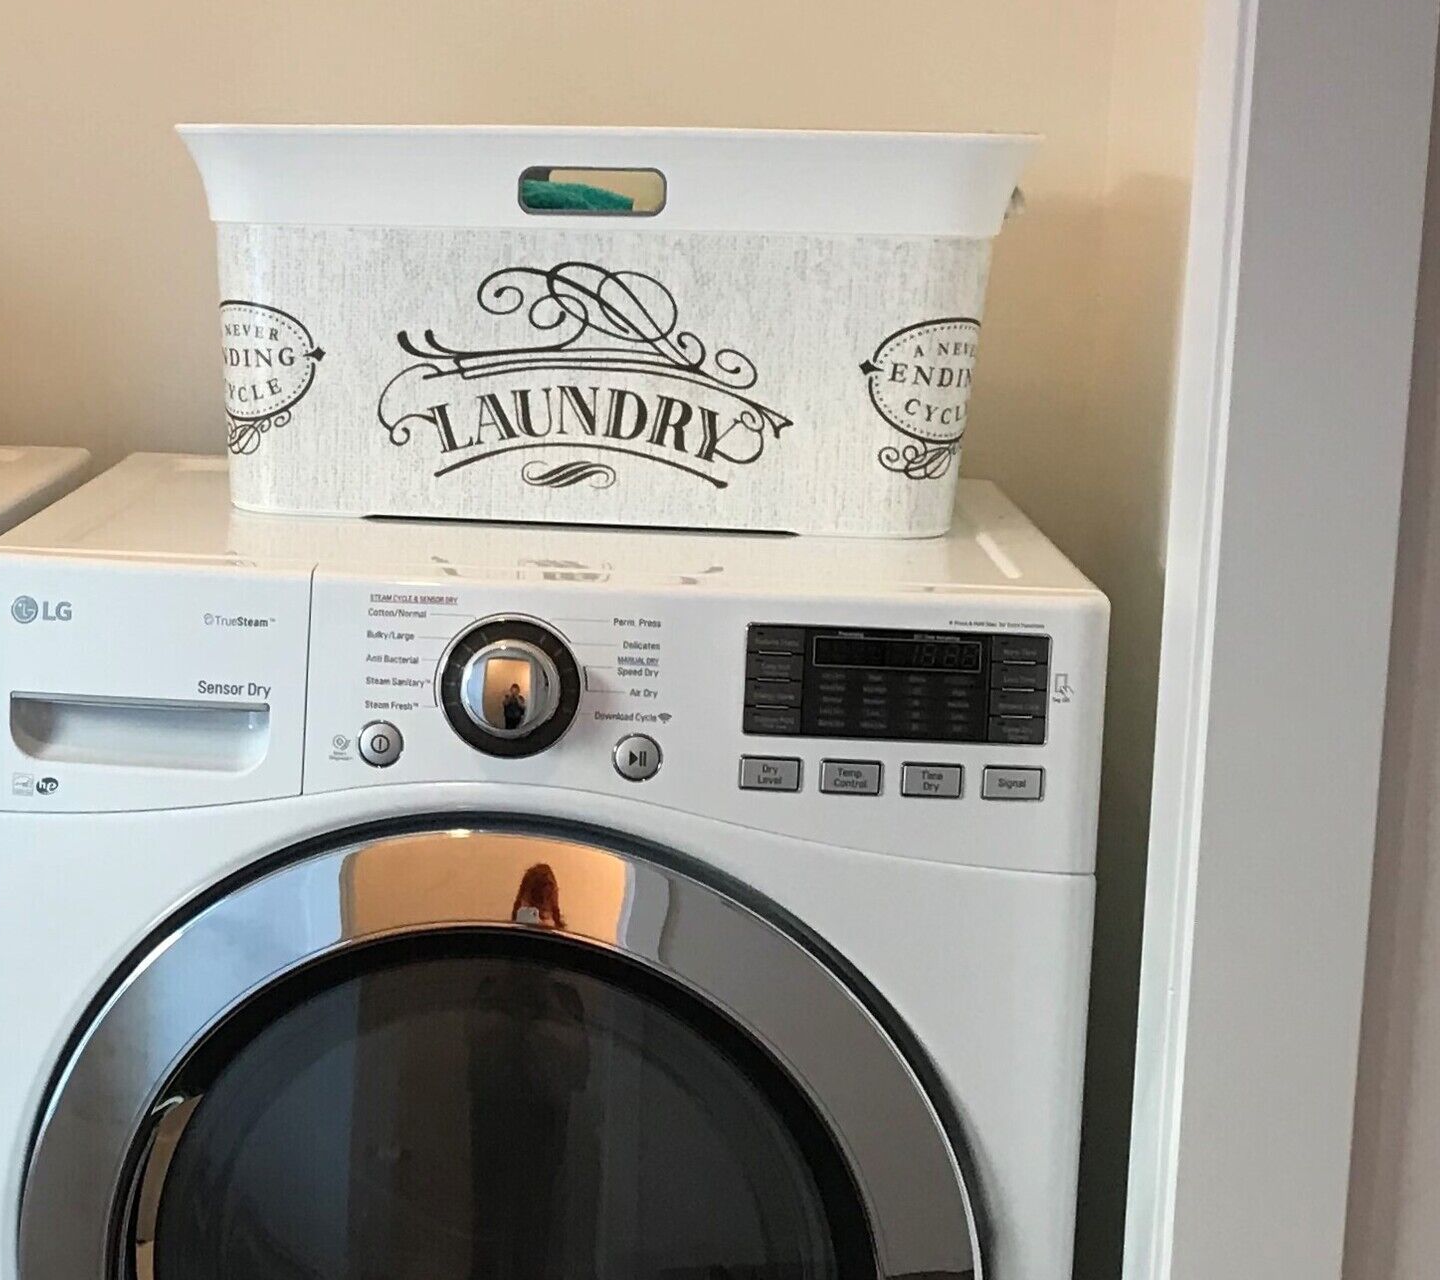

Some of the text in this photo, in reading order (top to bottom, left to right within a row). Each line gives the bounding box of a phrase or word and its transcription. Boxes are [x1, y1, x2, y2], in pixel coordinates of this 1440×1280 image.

[913, 341, 976, 358] A NEVE
[887, 361, 972, 389] ENDIN
[224, 377, 283, 403] YCLE
[903, 397, 967, 425] CYCL
[428, 384, 752, 465] LAUNDRY
[42, 600, 72, 621] LG
[367, 607, 427, 619] Cotton/Normal
[214, 615, 269, 628] TrueSteam
[197, 680, 272, 700] Sensor Dry
